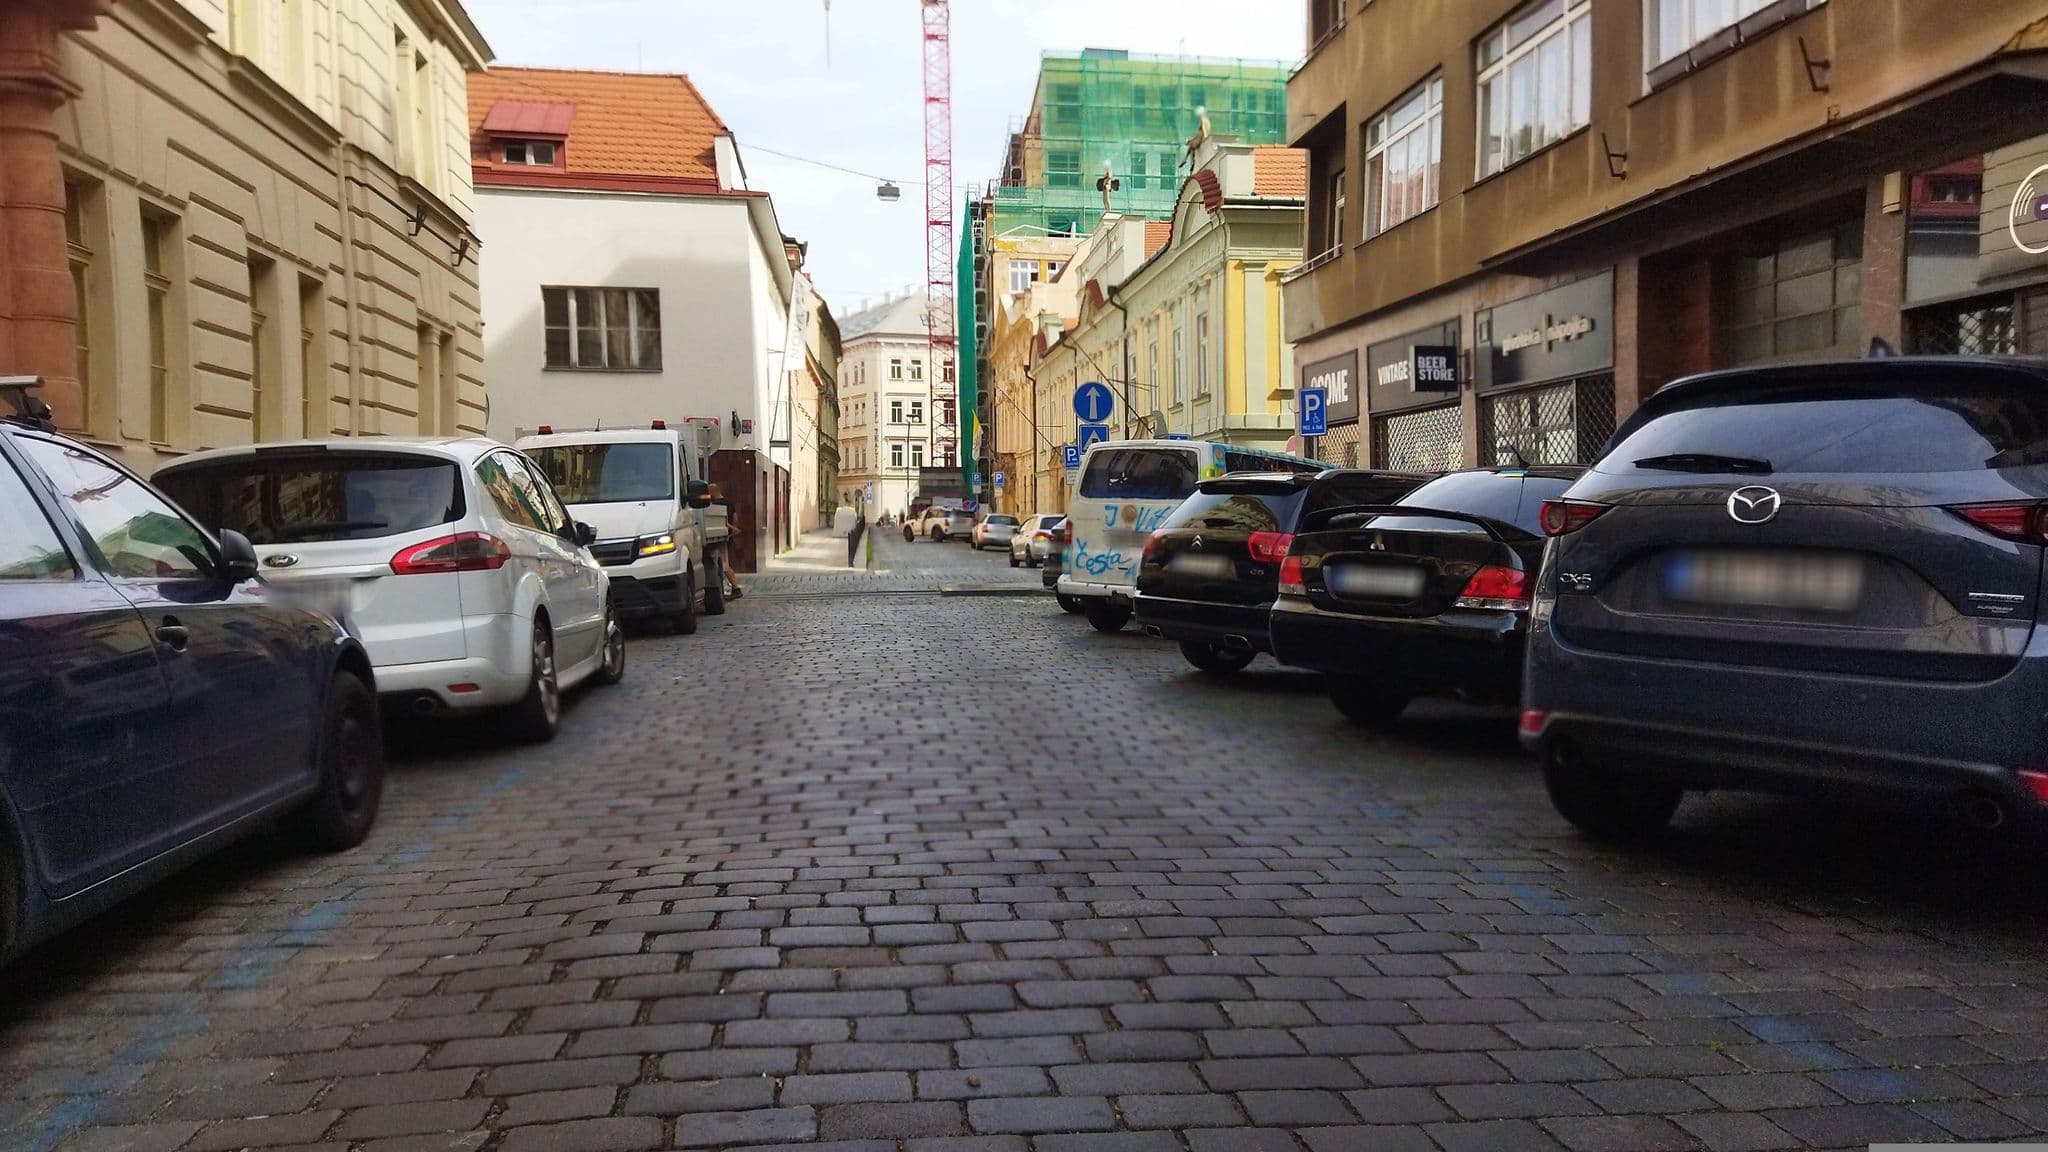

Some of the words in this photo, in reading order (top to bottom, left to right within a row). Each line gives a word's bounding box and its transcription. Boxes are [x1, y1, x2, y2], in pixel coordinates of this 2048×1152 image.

[1417, 356, 1447, 369] BEER
[1377, 360, 1409, 386] VINTAGE
[1419, 368, 1455, 381] STORE
[1304, 394, 1320, 421] P
[1067, 448, 1076, 462] P
[996, 473, 1003, 483] P
[1559, 573, 1592, 584] CX-5
